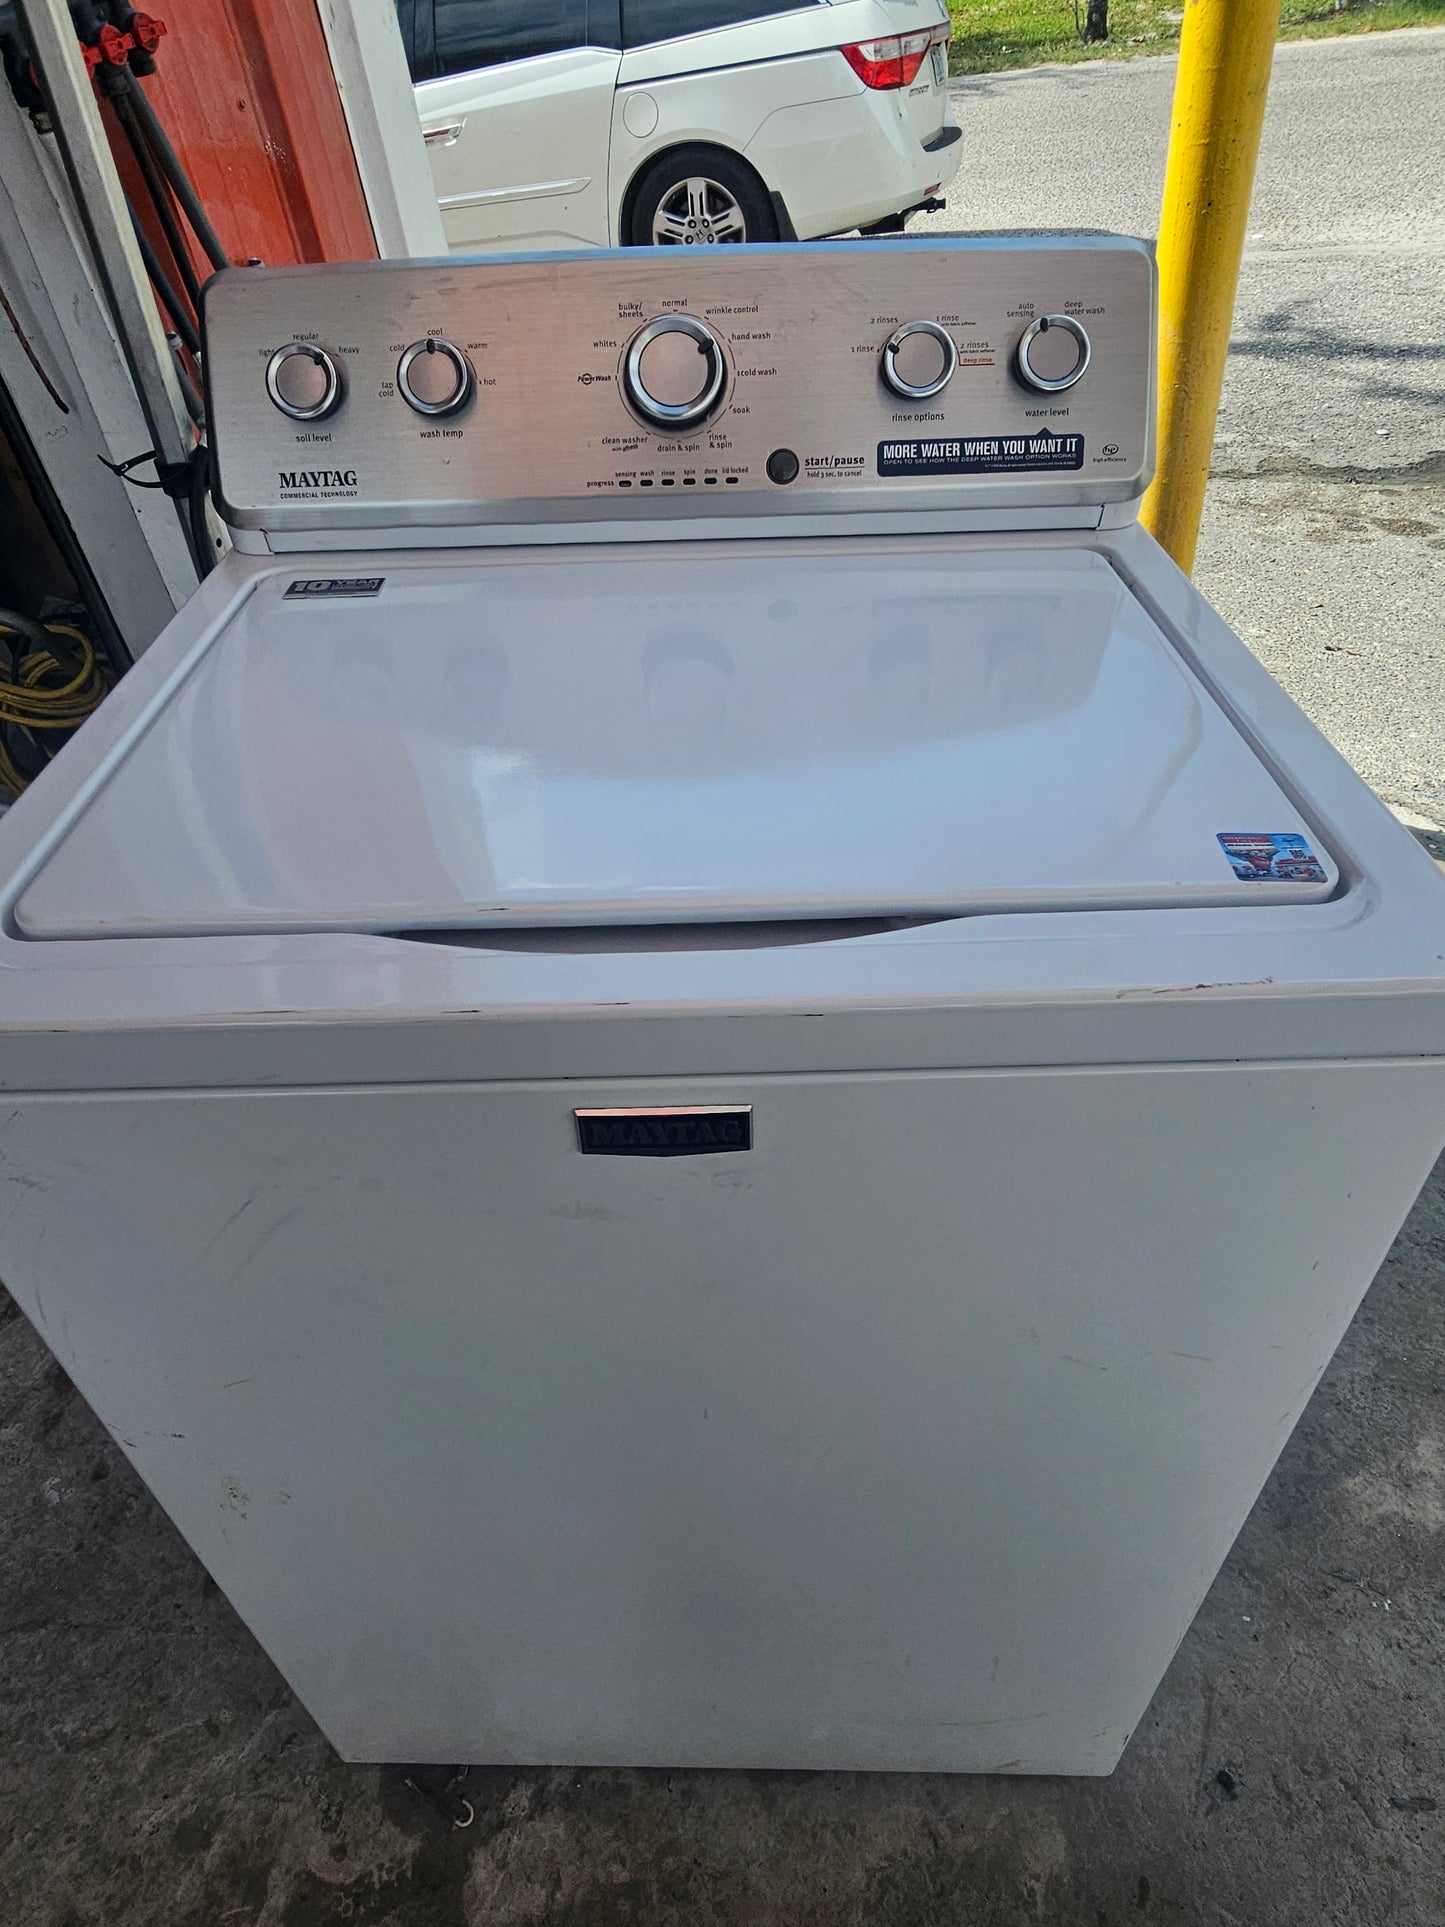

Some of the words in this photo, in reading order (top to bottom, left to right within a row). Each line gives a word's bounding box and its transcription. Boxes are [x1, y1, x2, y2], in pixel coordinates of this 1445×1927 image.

[619, 302, 642, 311] bulky/
[706, 306, 732, 314] wrinkle
[733, 305, 758, 313] control
[1064, 301, 1082, 309] deep
[1007, 310, 1034, 318] sensing
[1086, 306, 1105, 314] wash
[877, 315, 898, 324] rinses
[293, 332, 319, 341] regular
[339, 346, 360, 354] heavy
[741, 368, 756, 376] cold
[758, 367, 777, 375] wash
[379, 389, 394, 397] cold
[733, 406, 750, 414] soak
[1050, 407, 1069, 416] level
[892, 413, 912, 422] rinse
[914, 412, 945, 421] options
[312, 433, 332, 441] level
[420, 430, 440, 439] wash
[443, 428, 463, 438] temp
[657, 444, 676, 452] drain
[685, 442, 700, 451] spin
[717, 441, 732, 449] spin
[884, 444, 918, 459] MORE
[921, 442, 960, 458] WATER
[964, 440, 999, 456] WHEN
[1003, 440, 1026, 454] YOU
[1029, 438, 1063, 453] WANT
[1066, 438, 1079, 452] IT
[804, 455, 865, 468] start/pause
[278, 470, 358, 489] MAYTAG
[294, 581, 332, 592] 10
[589, 1121, 743, 1145] MAYTAG
